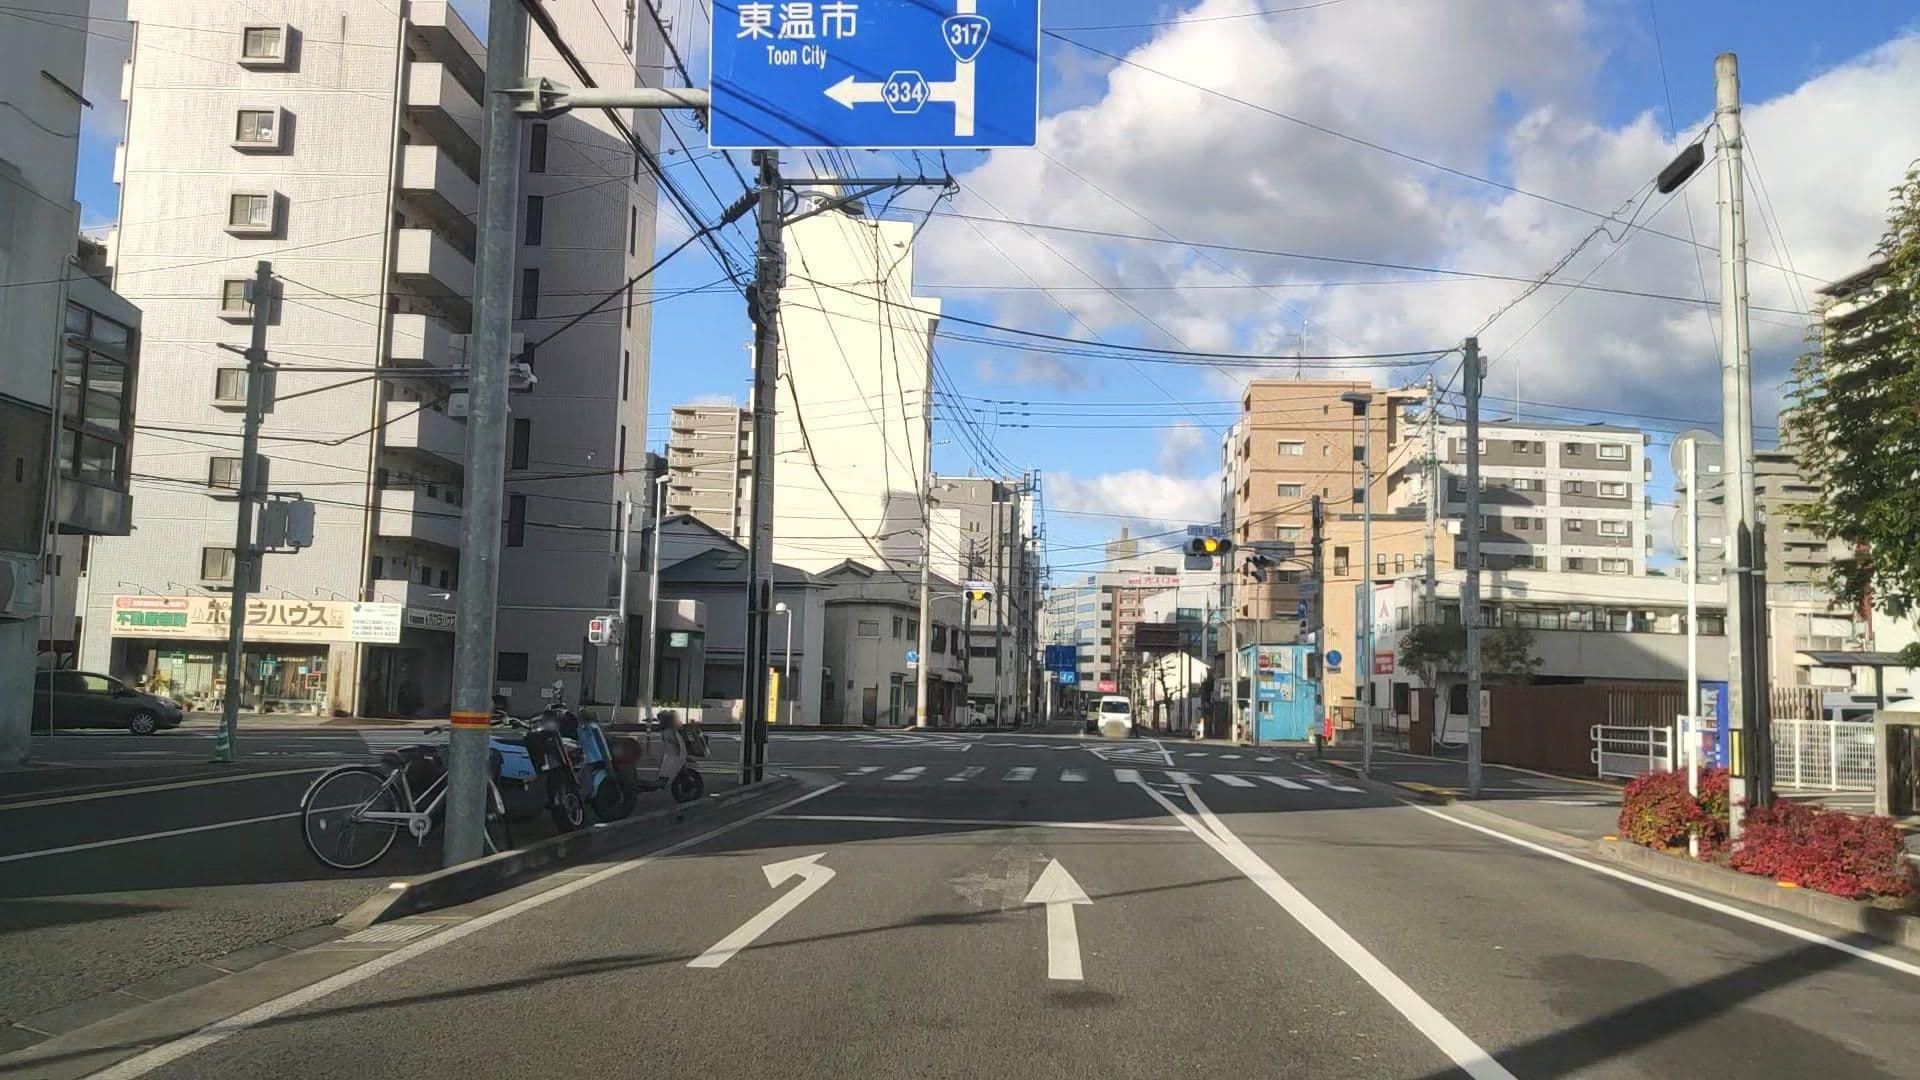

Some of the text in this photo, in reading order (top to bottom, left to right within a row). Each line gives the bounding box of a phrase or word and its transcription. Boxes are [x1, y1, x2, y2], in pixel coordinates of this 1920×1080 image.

[736, 1, 859, 41] 東温市
[950, 23, 982, 46] 317
[766, 45, 828, 70] Toon City
[888, 81, 923, 103] 334
[206, 601, 328, 626] ポラハウス
